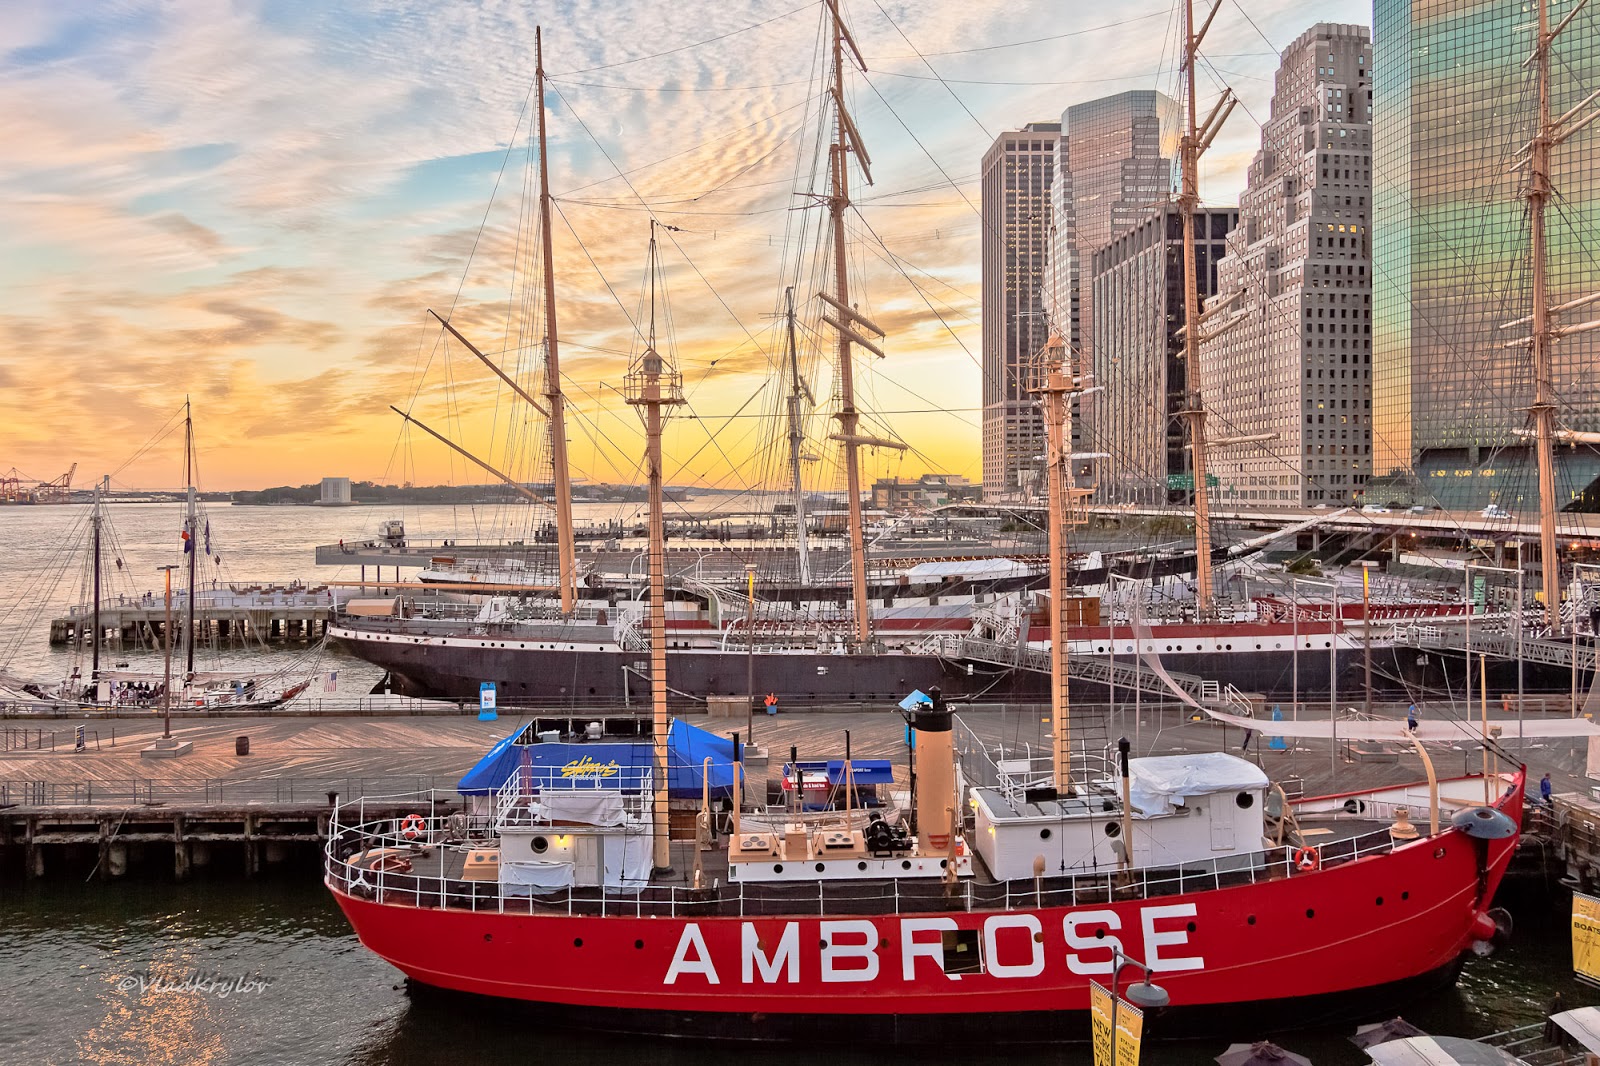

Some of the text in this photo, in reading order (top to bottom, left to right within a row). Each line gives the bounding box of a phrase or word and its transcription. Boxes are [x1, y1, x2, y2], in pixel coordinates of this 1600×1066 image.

[663, 903, 1206, 985] AMBROSE
[1093, 1018, 1111, 1038] NEW
[1094, 1031, 1110, 1051] YORK
